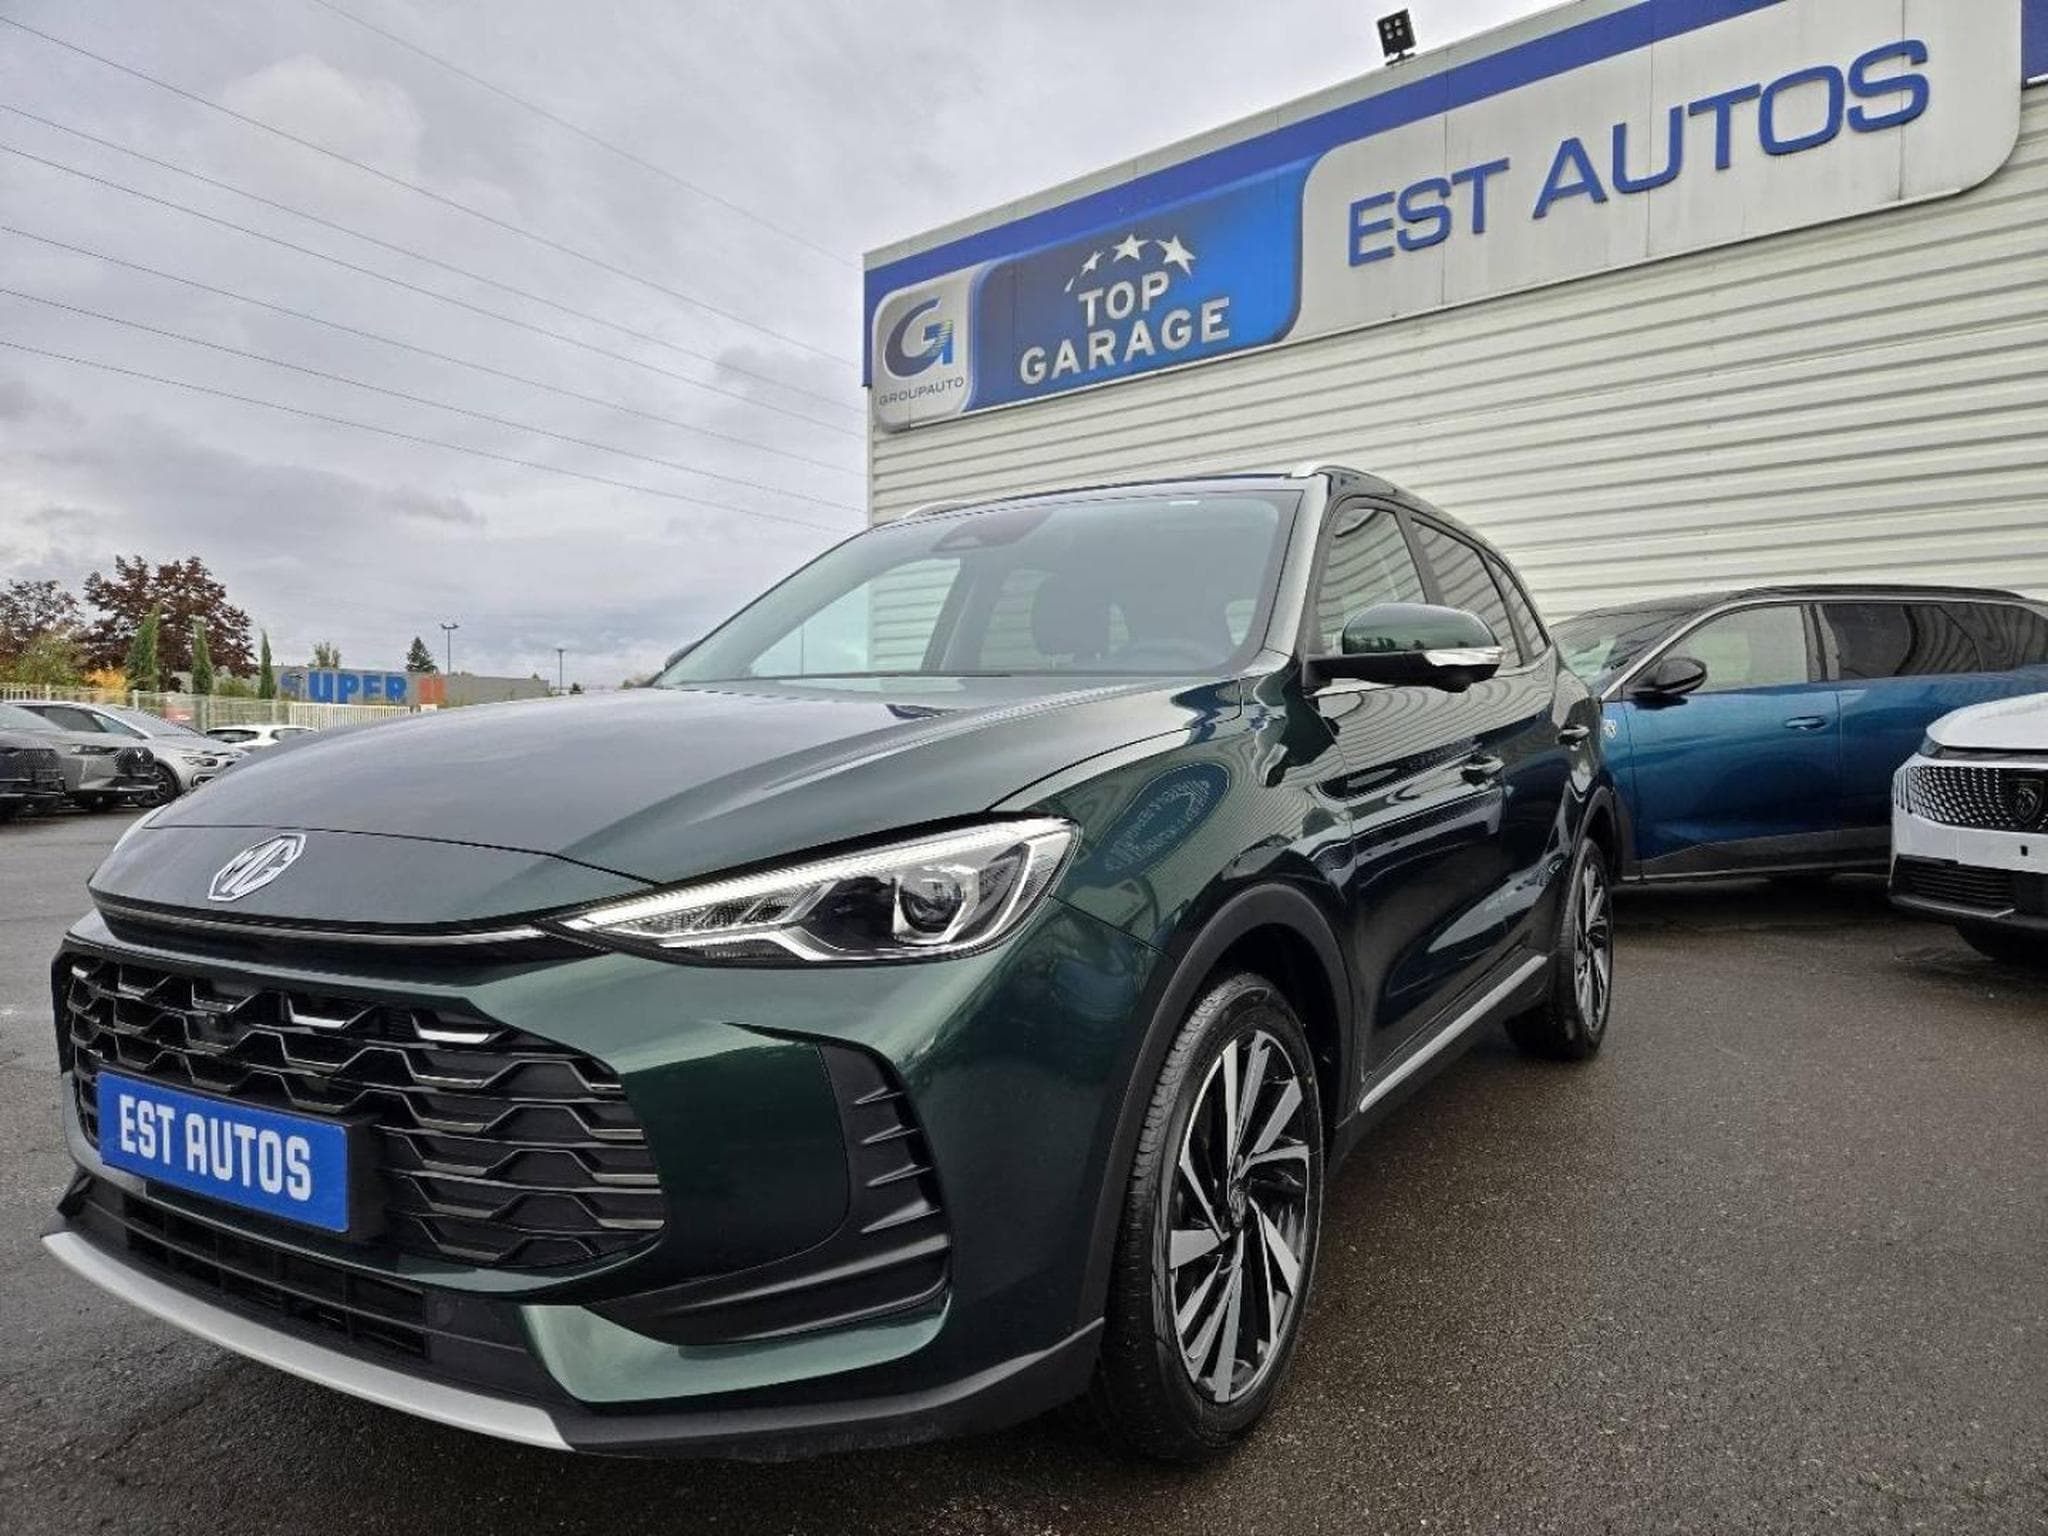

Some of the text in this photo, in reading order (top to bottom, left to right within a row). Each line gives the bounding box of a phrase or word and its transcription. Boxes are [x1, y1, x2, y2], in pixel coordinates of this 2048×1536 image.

[1348, 38, 1930, 267] EST AUTOS
[1078, 271, 1171, 328] TOP
[1020, 296, 1231, 385] GARAGE
[879, 376, 965, 406] GROUPAUTO
[214, 836, 302, 899] MG
[118, 1094, 312, 1201] EST AUTOS
